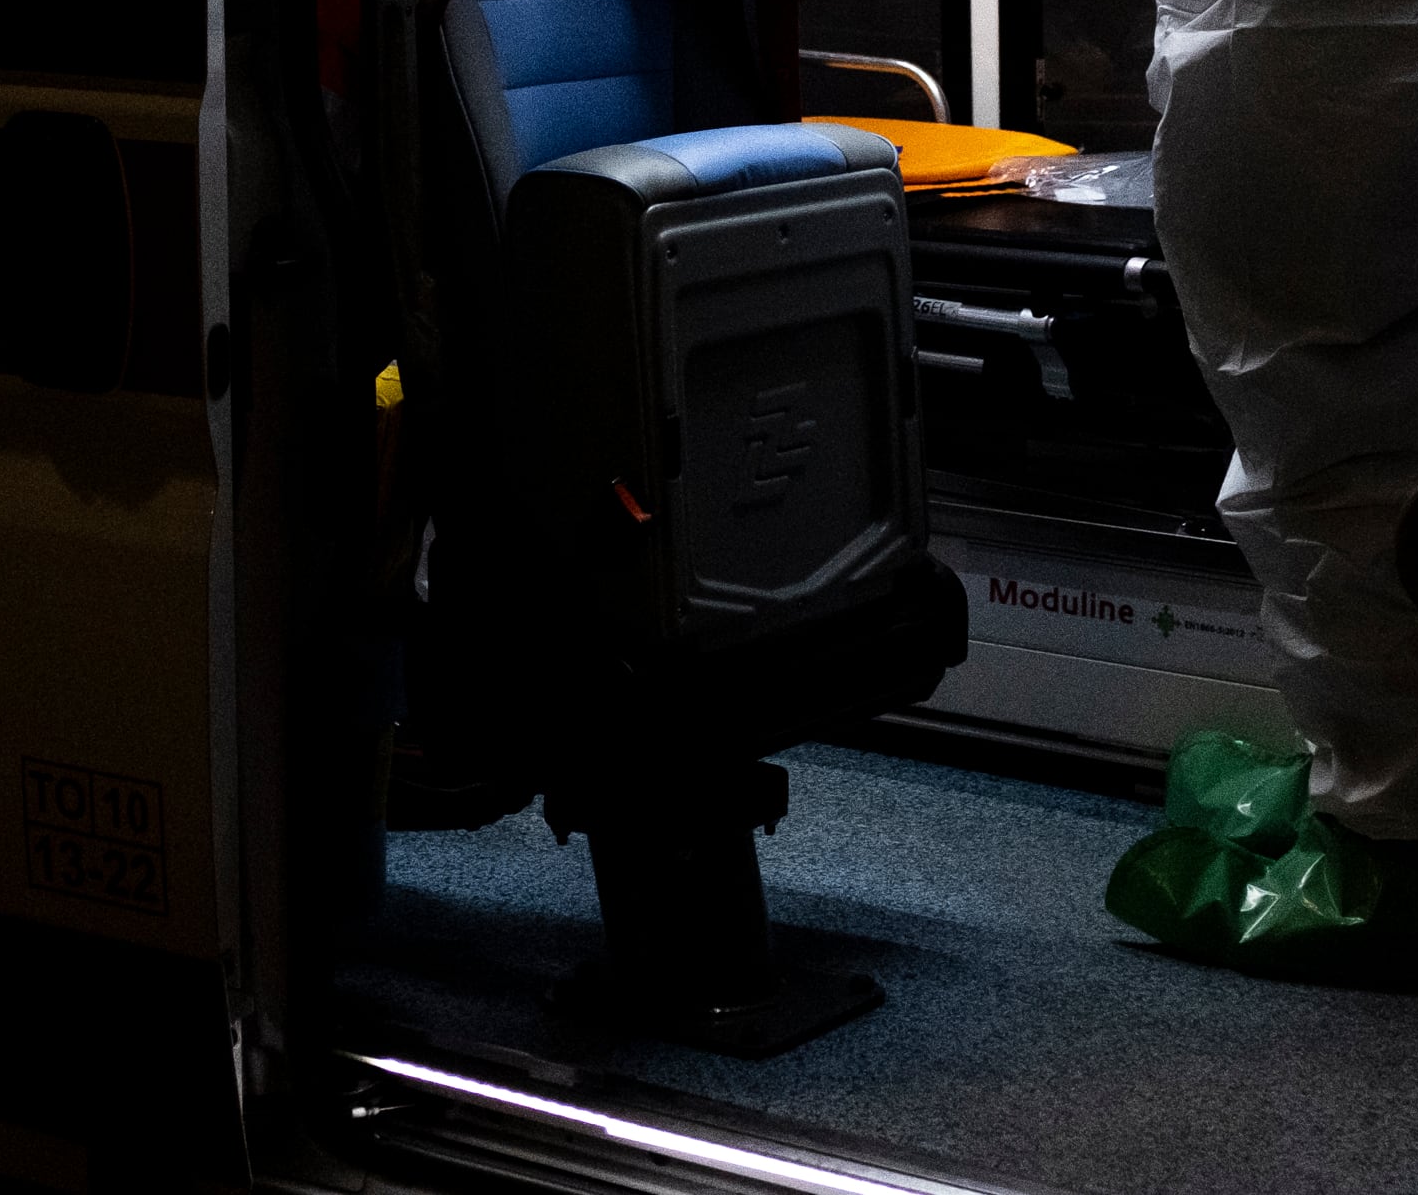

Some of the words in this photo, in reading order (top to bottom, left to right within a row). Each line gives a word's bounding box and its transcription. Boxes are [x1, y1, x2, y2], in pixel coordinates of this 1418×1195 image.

[988, 577, 1134, 625] Moduline
[29, 770, 86, 820] TO
[102, 787, 148, 834] 10
[35, 835, 159, 902] 13-22
